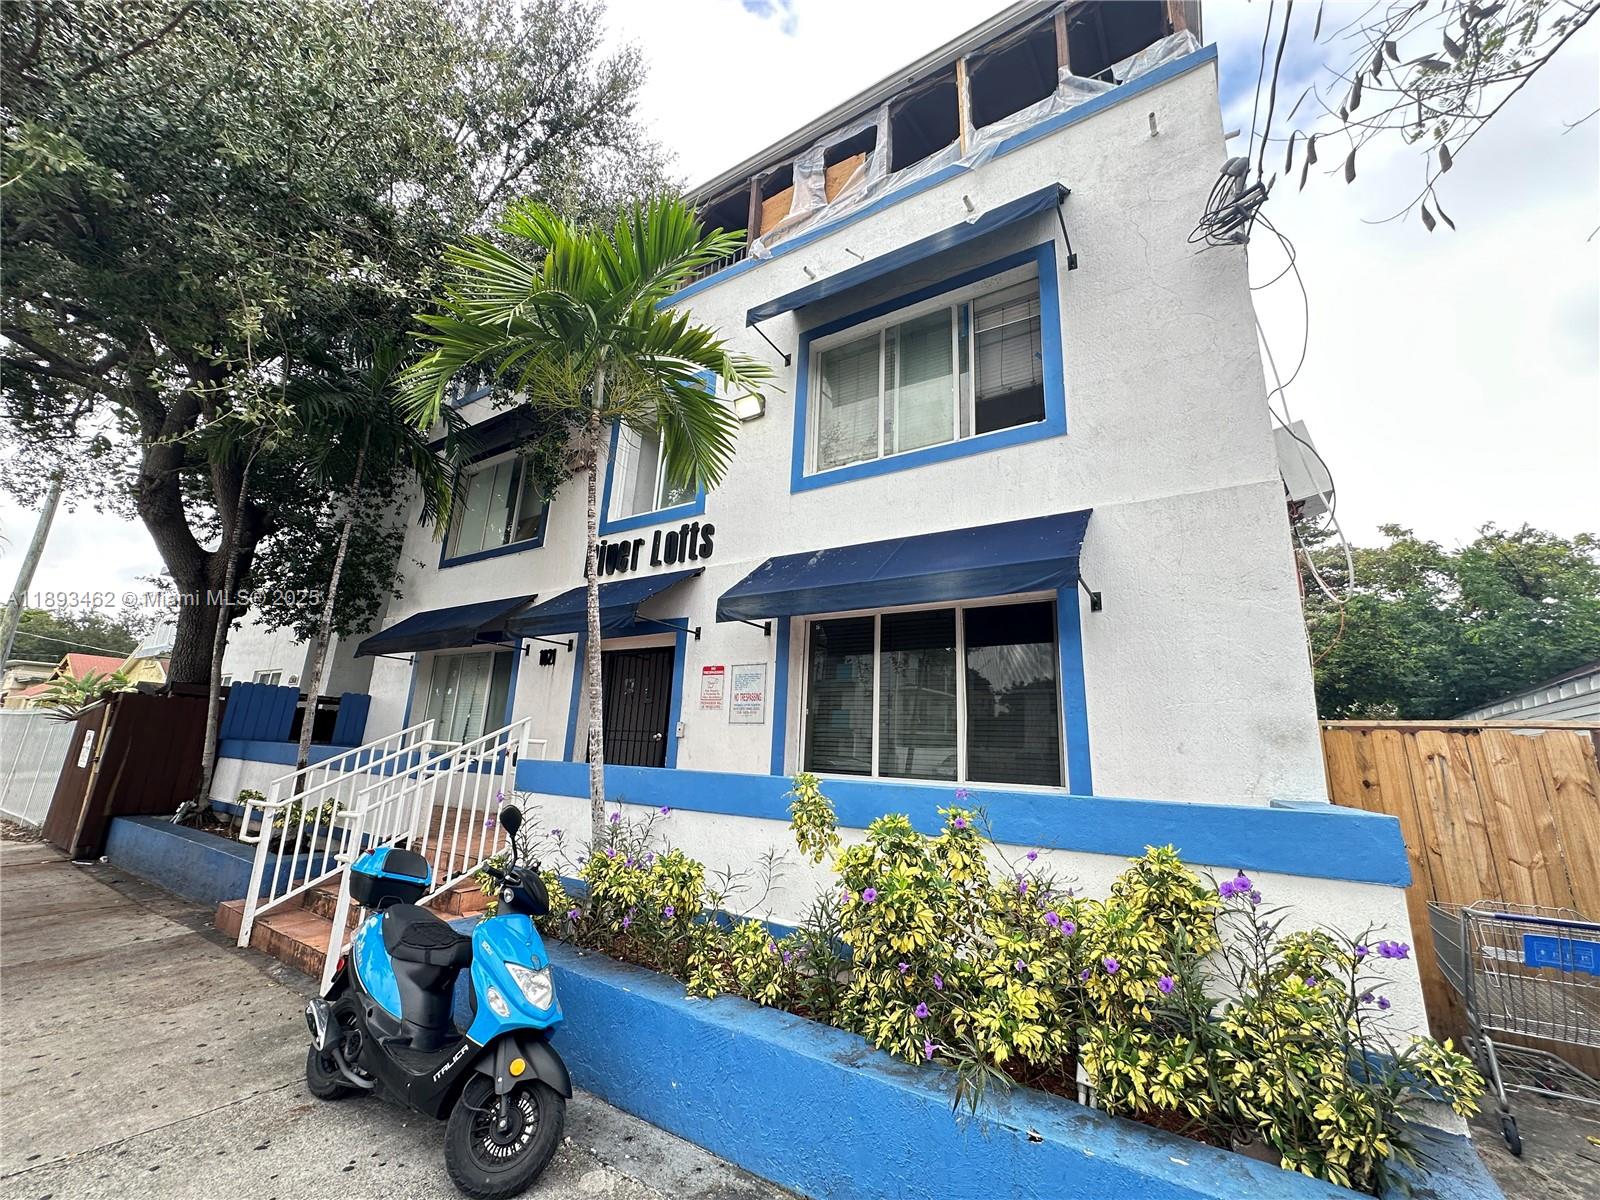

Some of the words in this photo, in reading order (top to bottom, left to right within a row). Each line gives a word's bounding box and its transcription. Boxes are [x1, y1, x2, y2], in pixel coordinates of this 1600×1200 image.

[584, 538, 645, 578] iver
[650, 522, 715, 567] Lofts
[432, 1044, 469, 1082] ITALICA
